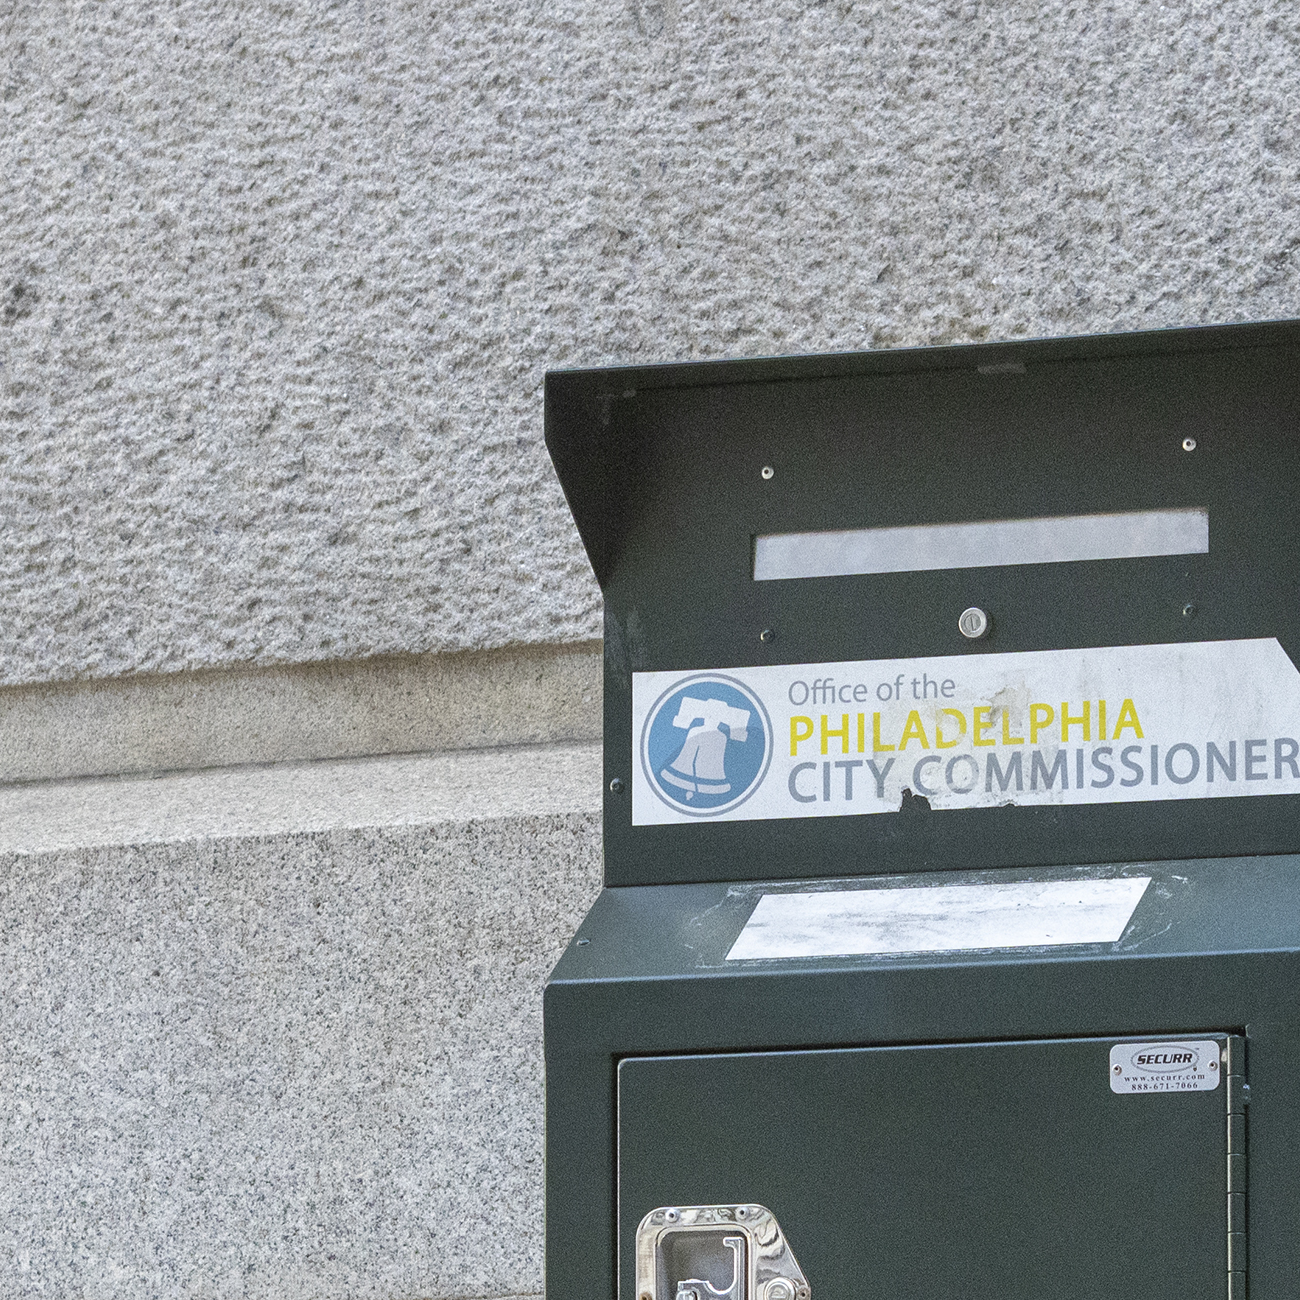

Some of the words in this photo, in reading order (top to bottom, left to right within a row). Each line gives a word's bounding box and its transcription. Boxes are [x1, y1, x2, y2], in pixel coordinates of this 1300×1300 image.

[787, 676, 868, 706] Office
[875, 673, 905, 701] of
[909, 673, 956, 700] the
[788, 699, 1145, 757] PHILADELPHIA
[787, 758, 898, 804] CITY
[1137, 1053, 1193, 1065] SECURR
[1124, 1073, 1205, 1082] www.securr.com
